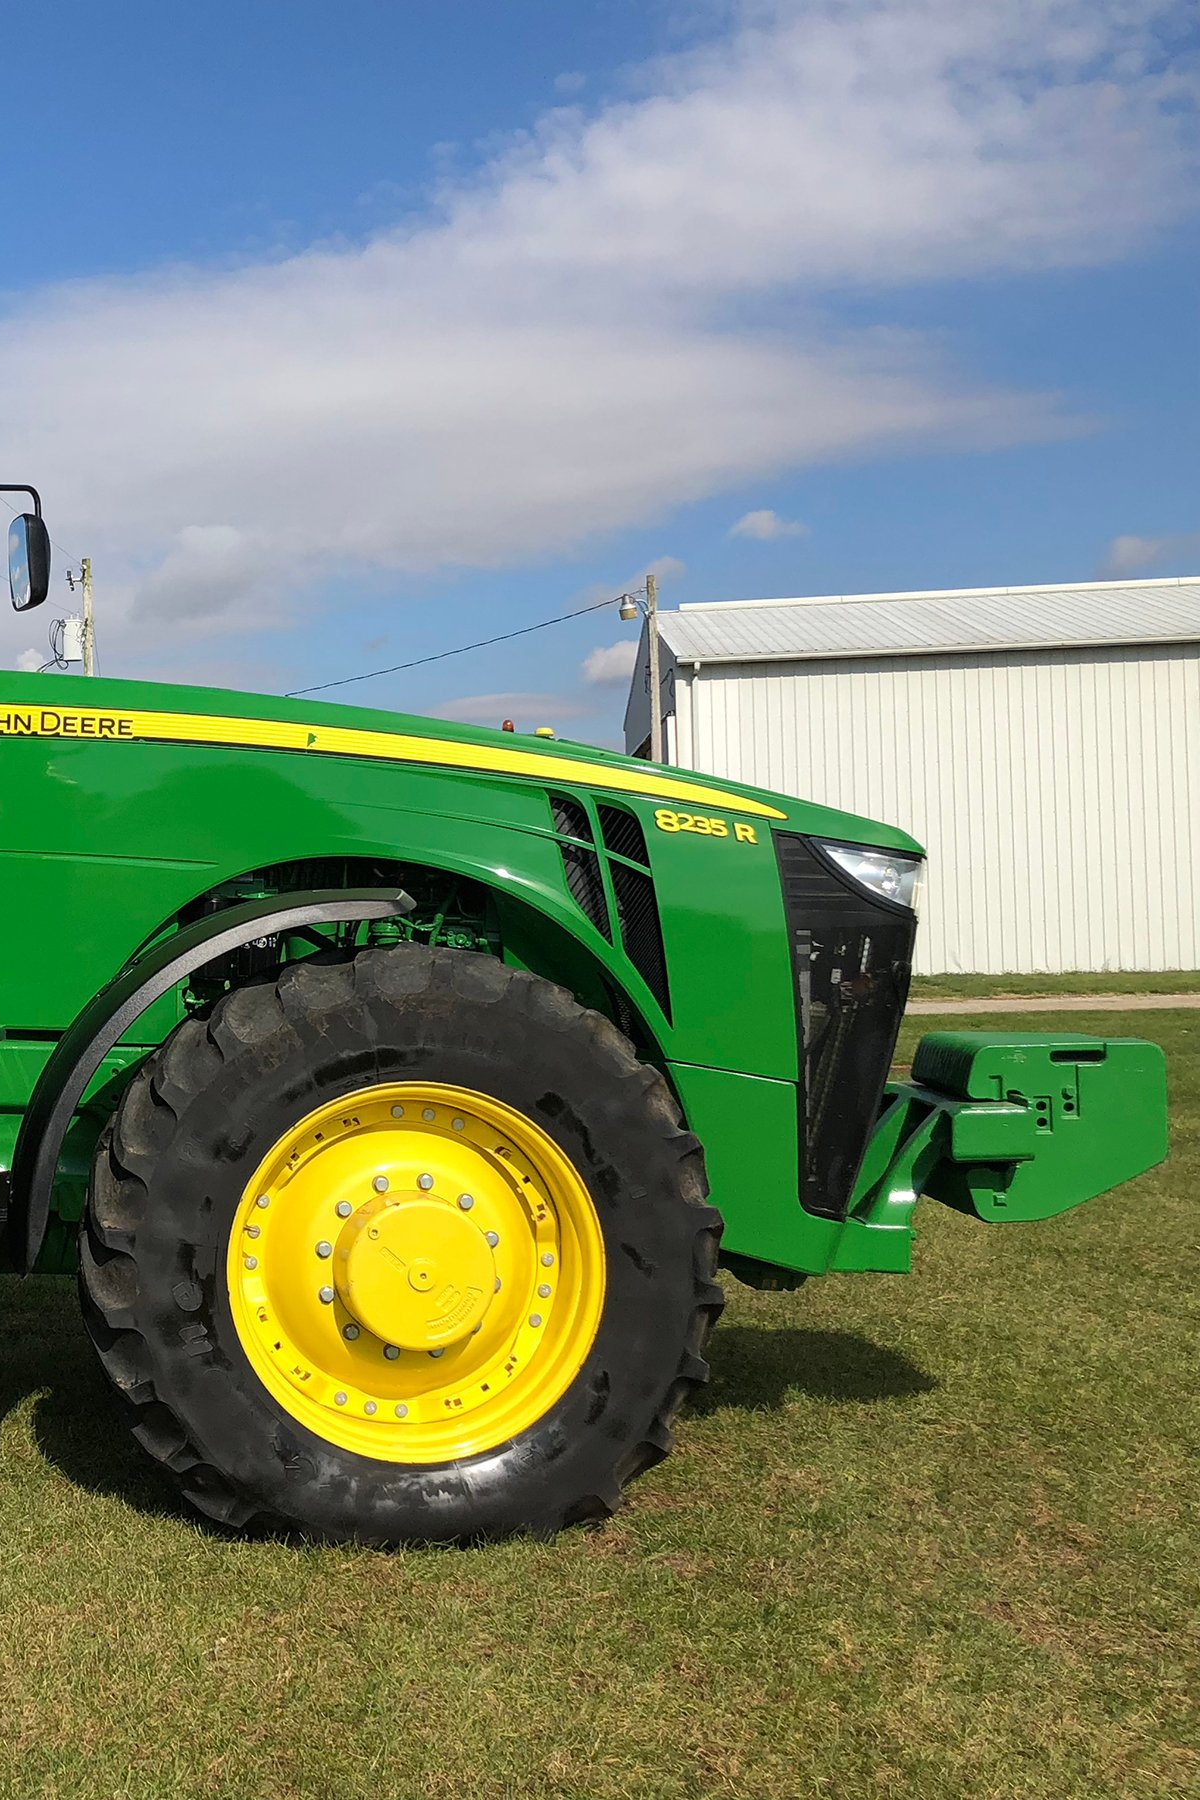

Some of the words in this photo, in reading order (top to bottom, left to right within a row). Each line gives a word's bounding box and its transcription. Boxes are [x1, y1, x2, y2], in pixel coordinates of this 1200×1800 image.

[41, 712, 134, 736] DEERE
[654, 809, 729, 837] 8235
[734, 822, 758, 844] R
